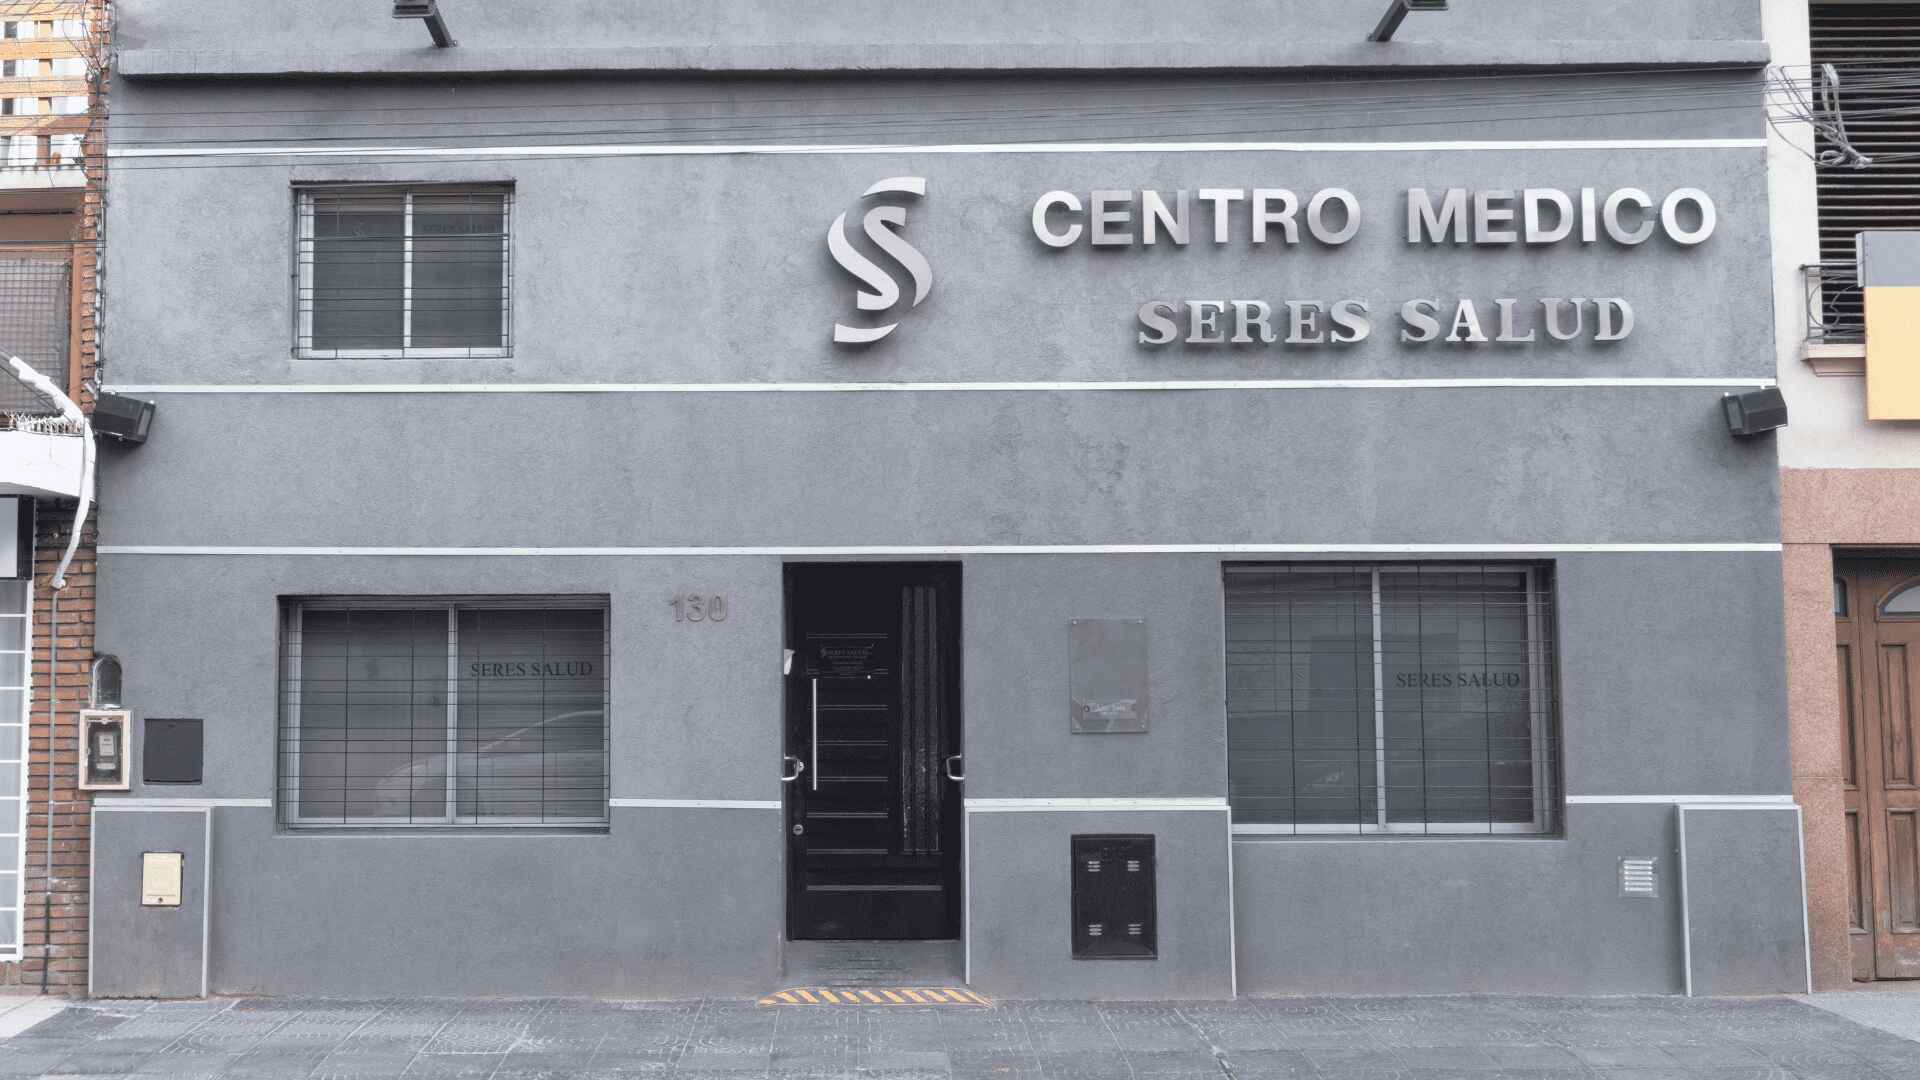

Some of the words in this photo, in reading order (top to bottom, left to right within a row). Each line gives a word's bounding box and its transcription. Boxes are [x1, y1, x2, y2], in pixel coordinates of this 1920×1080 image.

[1031, 187, 1362, 247] CENTRO
[1406, 187, 1718, 246] MEDICO
[1136, 299, 1371, 345] SERES
[1399, 297, 1635, 343] SALUD
[670, 594, 728, 623] 130
[471, 663, 526, 677] SERES
[530, 662, 592, 677] SALUD
[1395, 672, 1453, 688] SERES
[1456, 672, 1521, 687] SALUD
